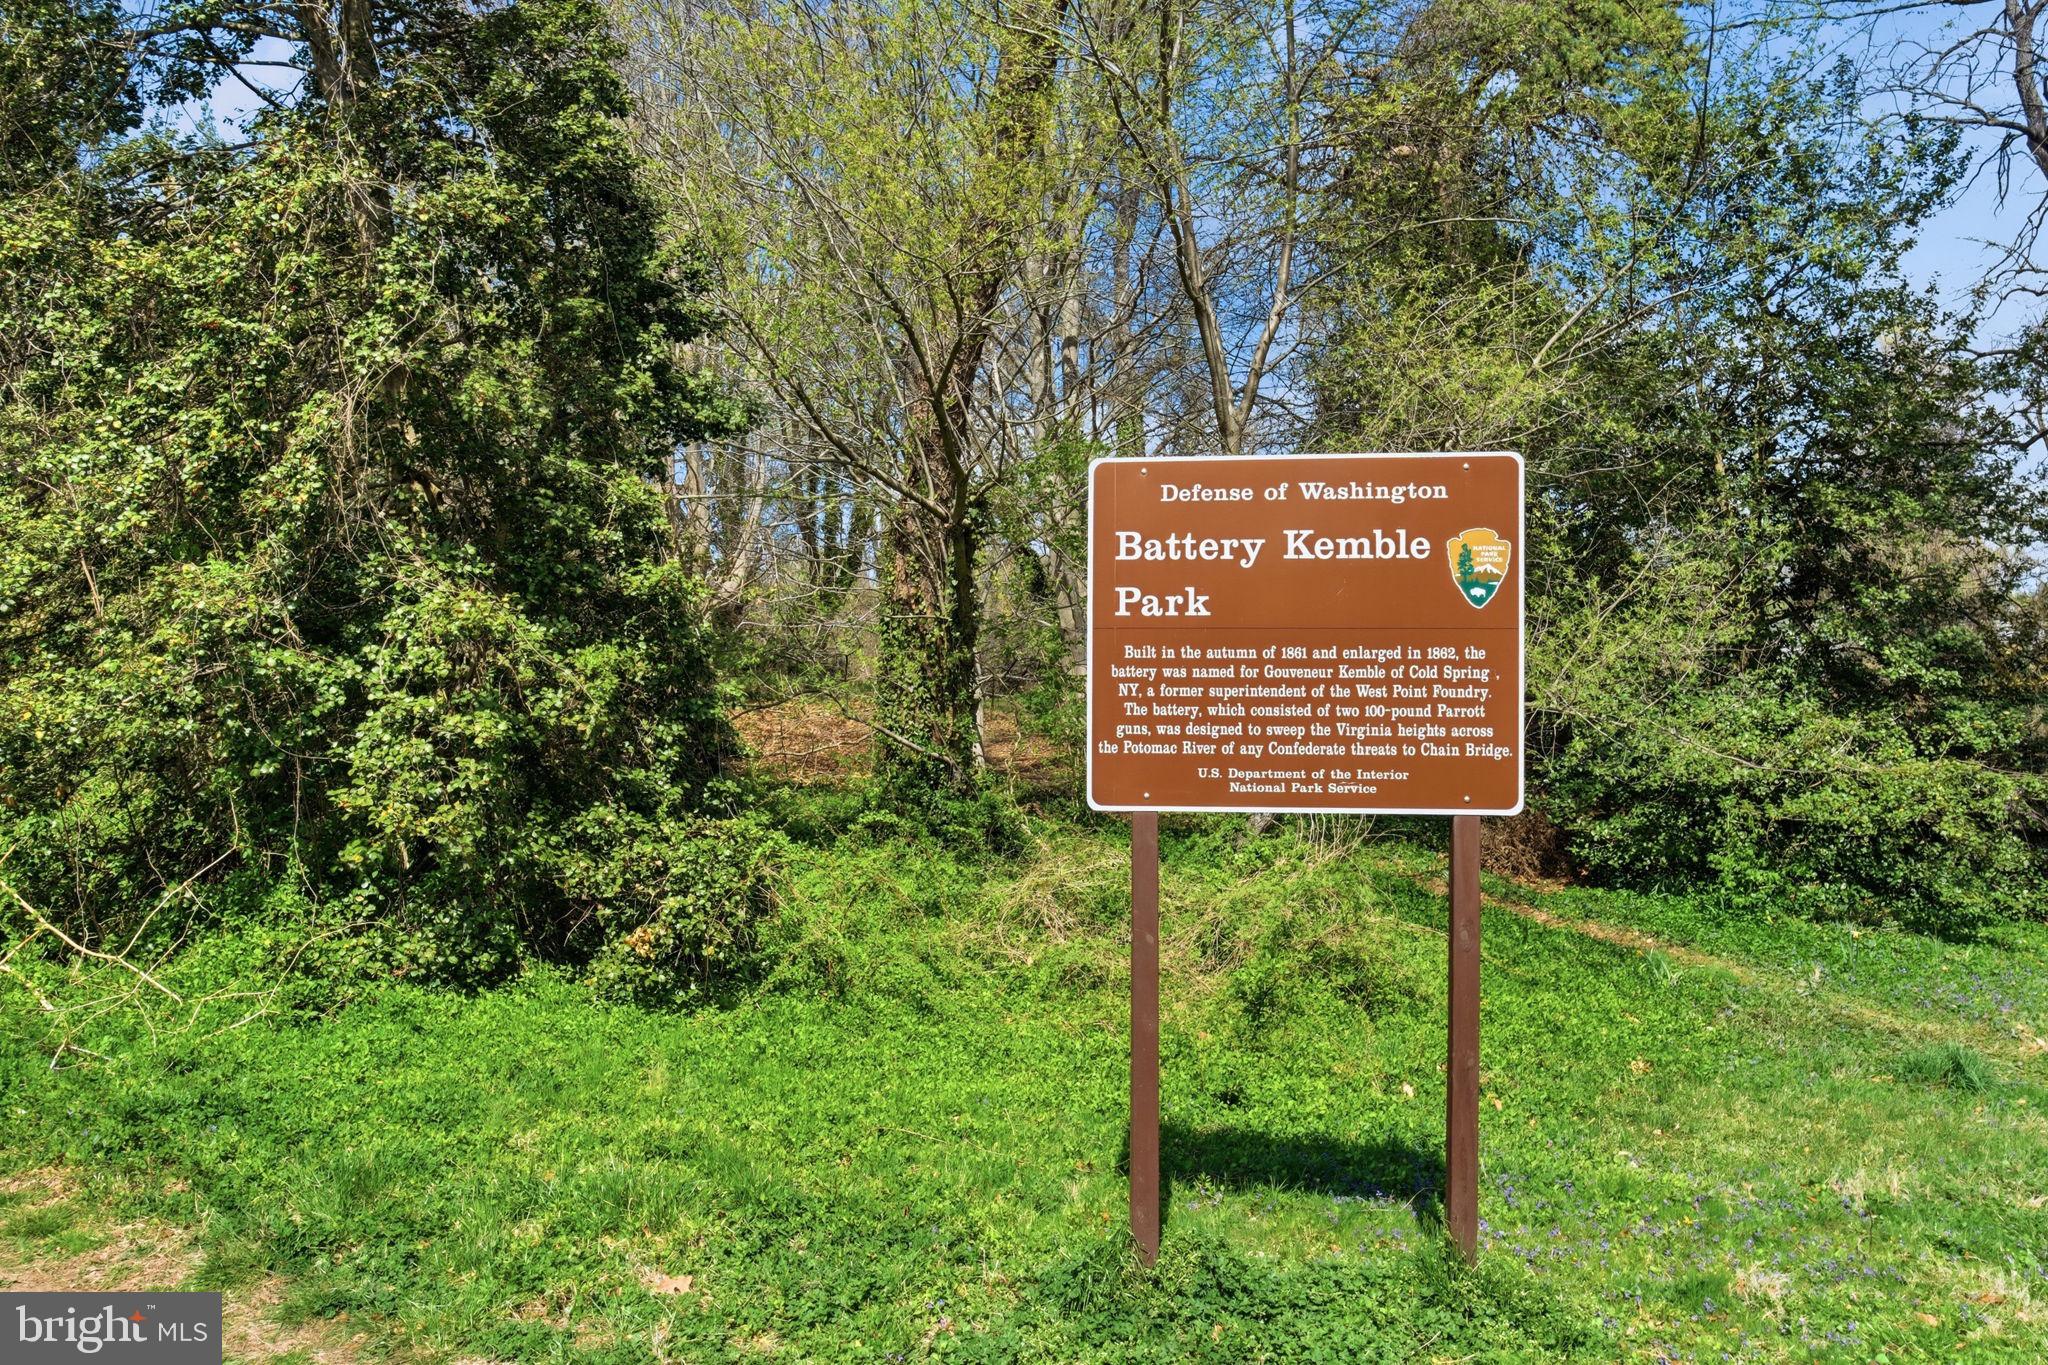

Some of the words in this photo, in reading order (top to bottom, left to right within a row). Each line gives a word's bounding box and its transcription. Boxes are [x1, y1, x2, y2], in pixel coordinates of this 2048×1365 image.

[1160, 483, 1254, 502] Defense
[1264, 482, 1289, 501] of
[1298, 481, 1448, 504] Washington
[1115, 531, 1266, 568] Battery
[1283, 529, 1430, 559] Kemble
[1115, 587, 1211, 616] Park
[1124, 645, 1156, 658] Built
[1162, 646, 1175, 658] in
[1181, 645, 1201, 659] the
[1206, 647, 1257, 659] autumn
[1263, 645, 1276, 659] of
[1281, 647, 1307, 659] 1861
[1312, 646, 1337, 659] and
[1343, 646, 1402, 663] enlarged
[1408, 646, 1421, 659] in
[1427, 647, 1459, 661] 1862,
[1465, 646, 1486, 659] the
[1111, 664, 1157, 681] battery
[1162, 668, 1186, 678] was
[1192, 665, 1235, 678] named
[1240, 665, 1259, 678] for
[1264, 665, 1333, 678] Gouveneur
[1339, 665, 1386, 678] Kemble
[1391, 665, 1404, 678] of
[1409, 665, 1438, 678] Cold
[1119, 683, 1142, 698] NY,
[1147, 687, 1155, 696] a
[1160, 683, 1204, 697] former
[1209, 684, 1306, 700] superintendent
[1311, 684, 1325, 697] of
[1330, 684, 1351, 697] the
[1356, 684, 1387, 697] West
[1393, 685, 1427, 698] Point
[1433, 685, 1491, 702] Foundry.
[1124, 702, 1147, 715] The
[1153, 703, 1202, 719] battery,
[1207, 703, 1245, 716] which
[1250, 704, 1312, 716] consisted
[1317, 703, 1331, 716] of
[1336, 705, 1360, 717] two
[1365, 704, 1432, 721] 100-pound
[1437, 704, 1485, 717] Parrott
[1116, 725, 1151, 738] guns,
[1156, 725, 1181, 735] was
[1185, 722, 1243, 739] designed
[1248, 723, 1261, 736] to
[1266, 726, 1305, 739] sweep
[1310, 723, 1331, 736] the
[1336, 723, 1392, 740] Virginia
[1398, 723, 1446, 740] heights
[1451, 727, 1493, 737] across
[1098, 740, 1118, 754] the
[1123, 740, 1177, 754] Potomac
[1182, 741, 1216, 754] River
[1222, 741, 1235, 754] of
[1240, 745, 1264, 758] any
[1268, 741, 1345, 756] Confederate
[1351, 742, 1397, 756] threats
[1402, 744, 1416, 756] to
[1421, 743, 1460, 756] Chain
[1465, 743, 1512, 760] Bridge.
[1198, 768, 1222, 778] U.S.
[1228, 768, 1306, 781] Department
[1312, 769, 1325, 779] of
[1331, 769, 1355, 784] the
[1357, 769, 1409, 780] Interior
[1230, 782, 1286, 792] National
[1292, 783, 1323, 793] Park
[1328, 782, 1377, 793] Service
